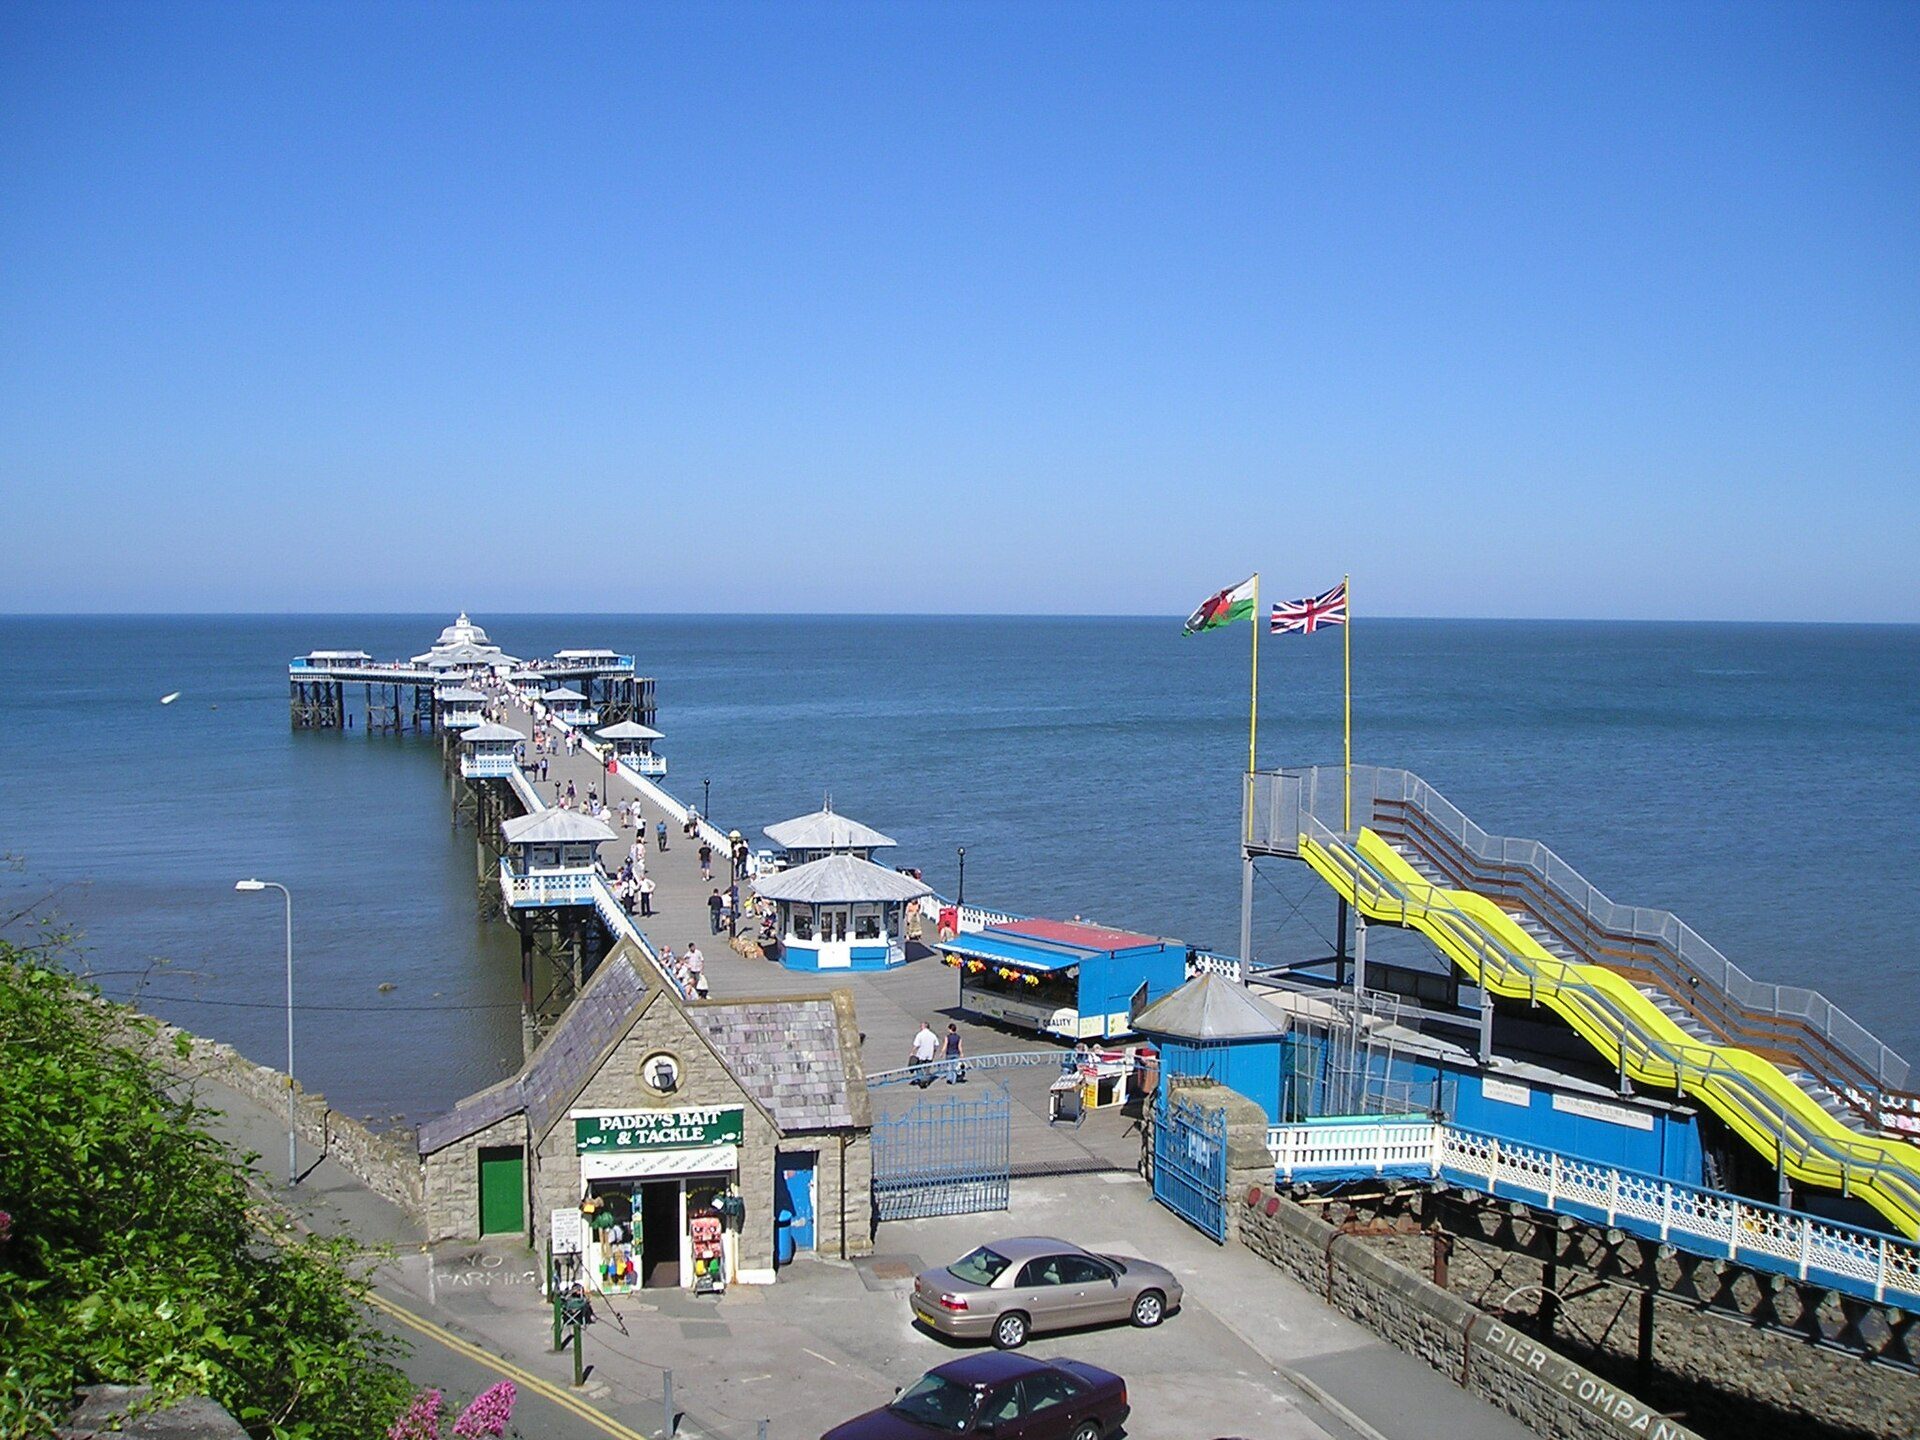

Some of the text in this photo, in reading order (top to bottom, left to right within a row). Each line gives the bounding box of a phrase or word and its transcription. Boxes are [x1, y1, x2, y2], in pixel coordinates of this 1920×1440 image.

[1047, 1053, 1077, 1065] PIER
[600, 1111, 721, 1130] PADDY'S BAIT
[616, 1127, 705, 1145] & TACKLE
[437, 1270, 535, 1286] PARKING
[1485, 1323, 1686, 1440] PIER COMPAN
